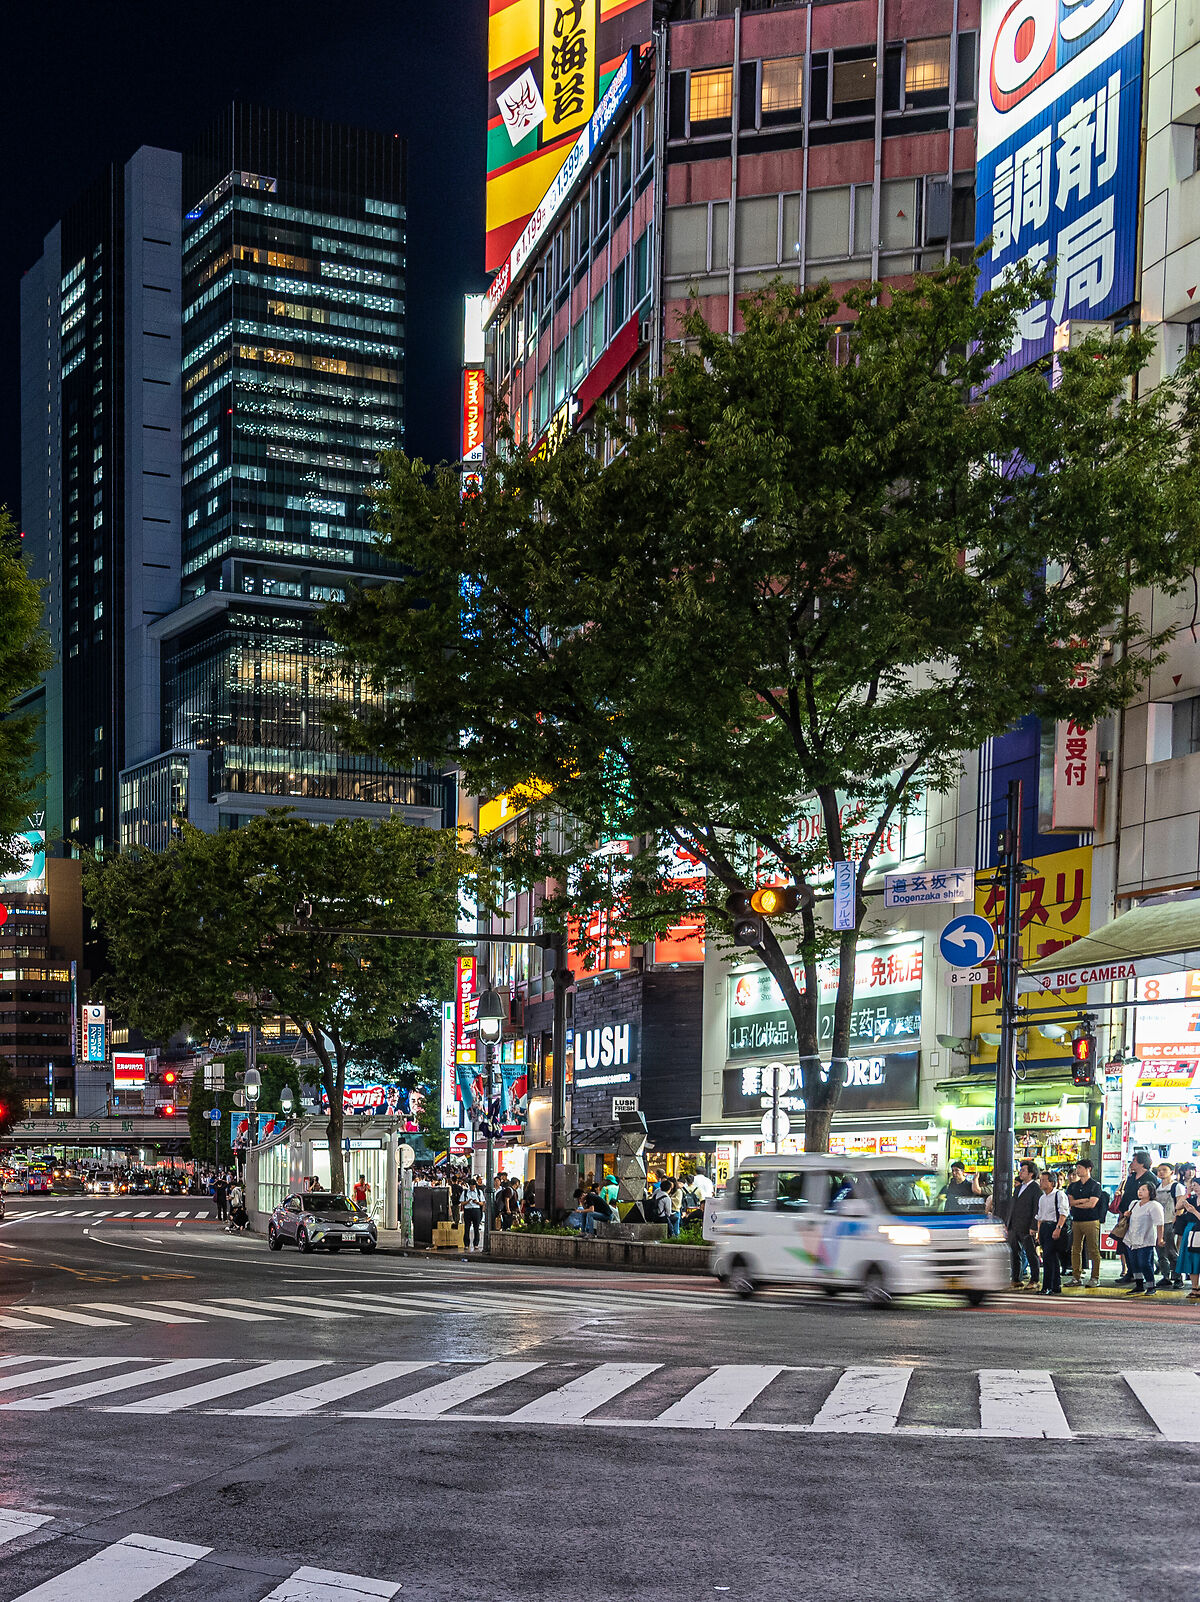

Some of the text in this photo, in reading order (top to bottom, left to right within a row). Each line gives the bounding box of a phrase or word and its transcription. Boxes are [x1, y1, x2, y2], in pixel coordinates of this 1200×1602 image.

[990, 69, 1121, 262] 調剤
[892, 872, 965, 893] 道玄坂下
[893, 892, 941, 903] Dogenzaka
[613, 950, 626, 959] 3F
[870, 951, 922, 988] 免税店
[1057, 963, 1137, 986] BIC CAMERA
[1144, 980, 1160, 1001] 8
[574, 1023, 630, 1071] LUSH
[1142, 1046, 1162, 1056] BIC
[718, 1167, 728, 1180] 15
